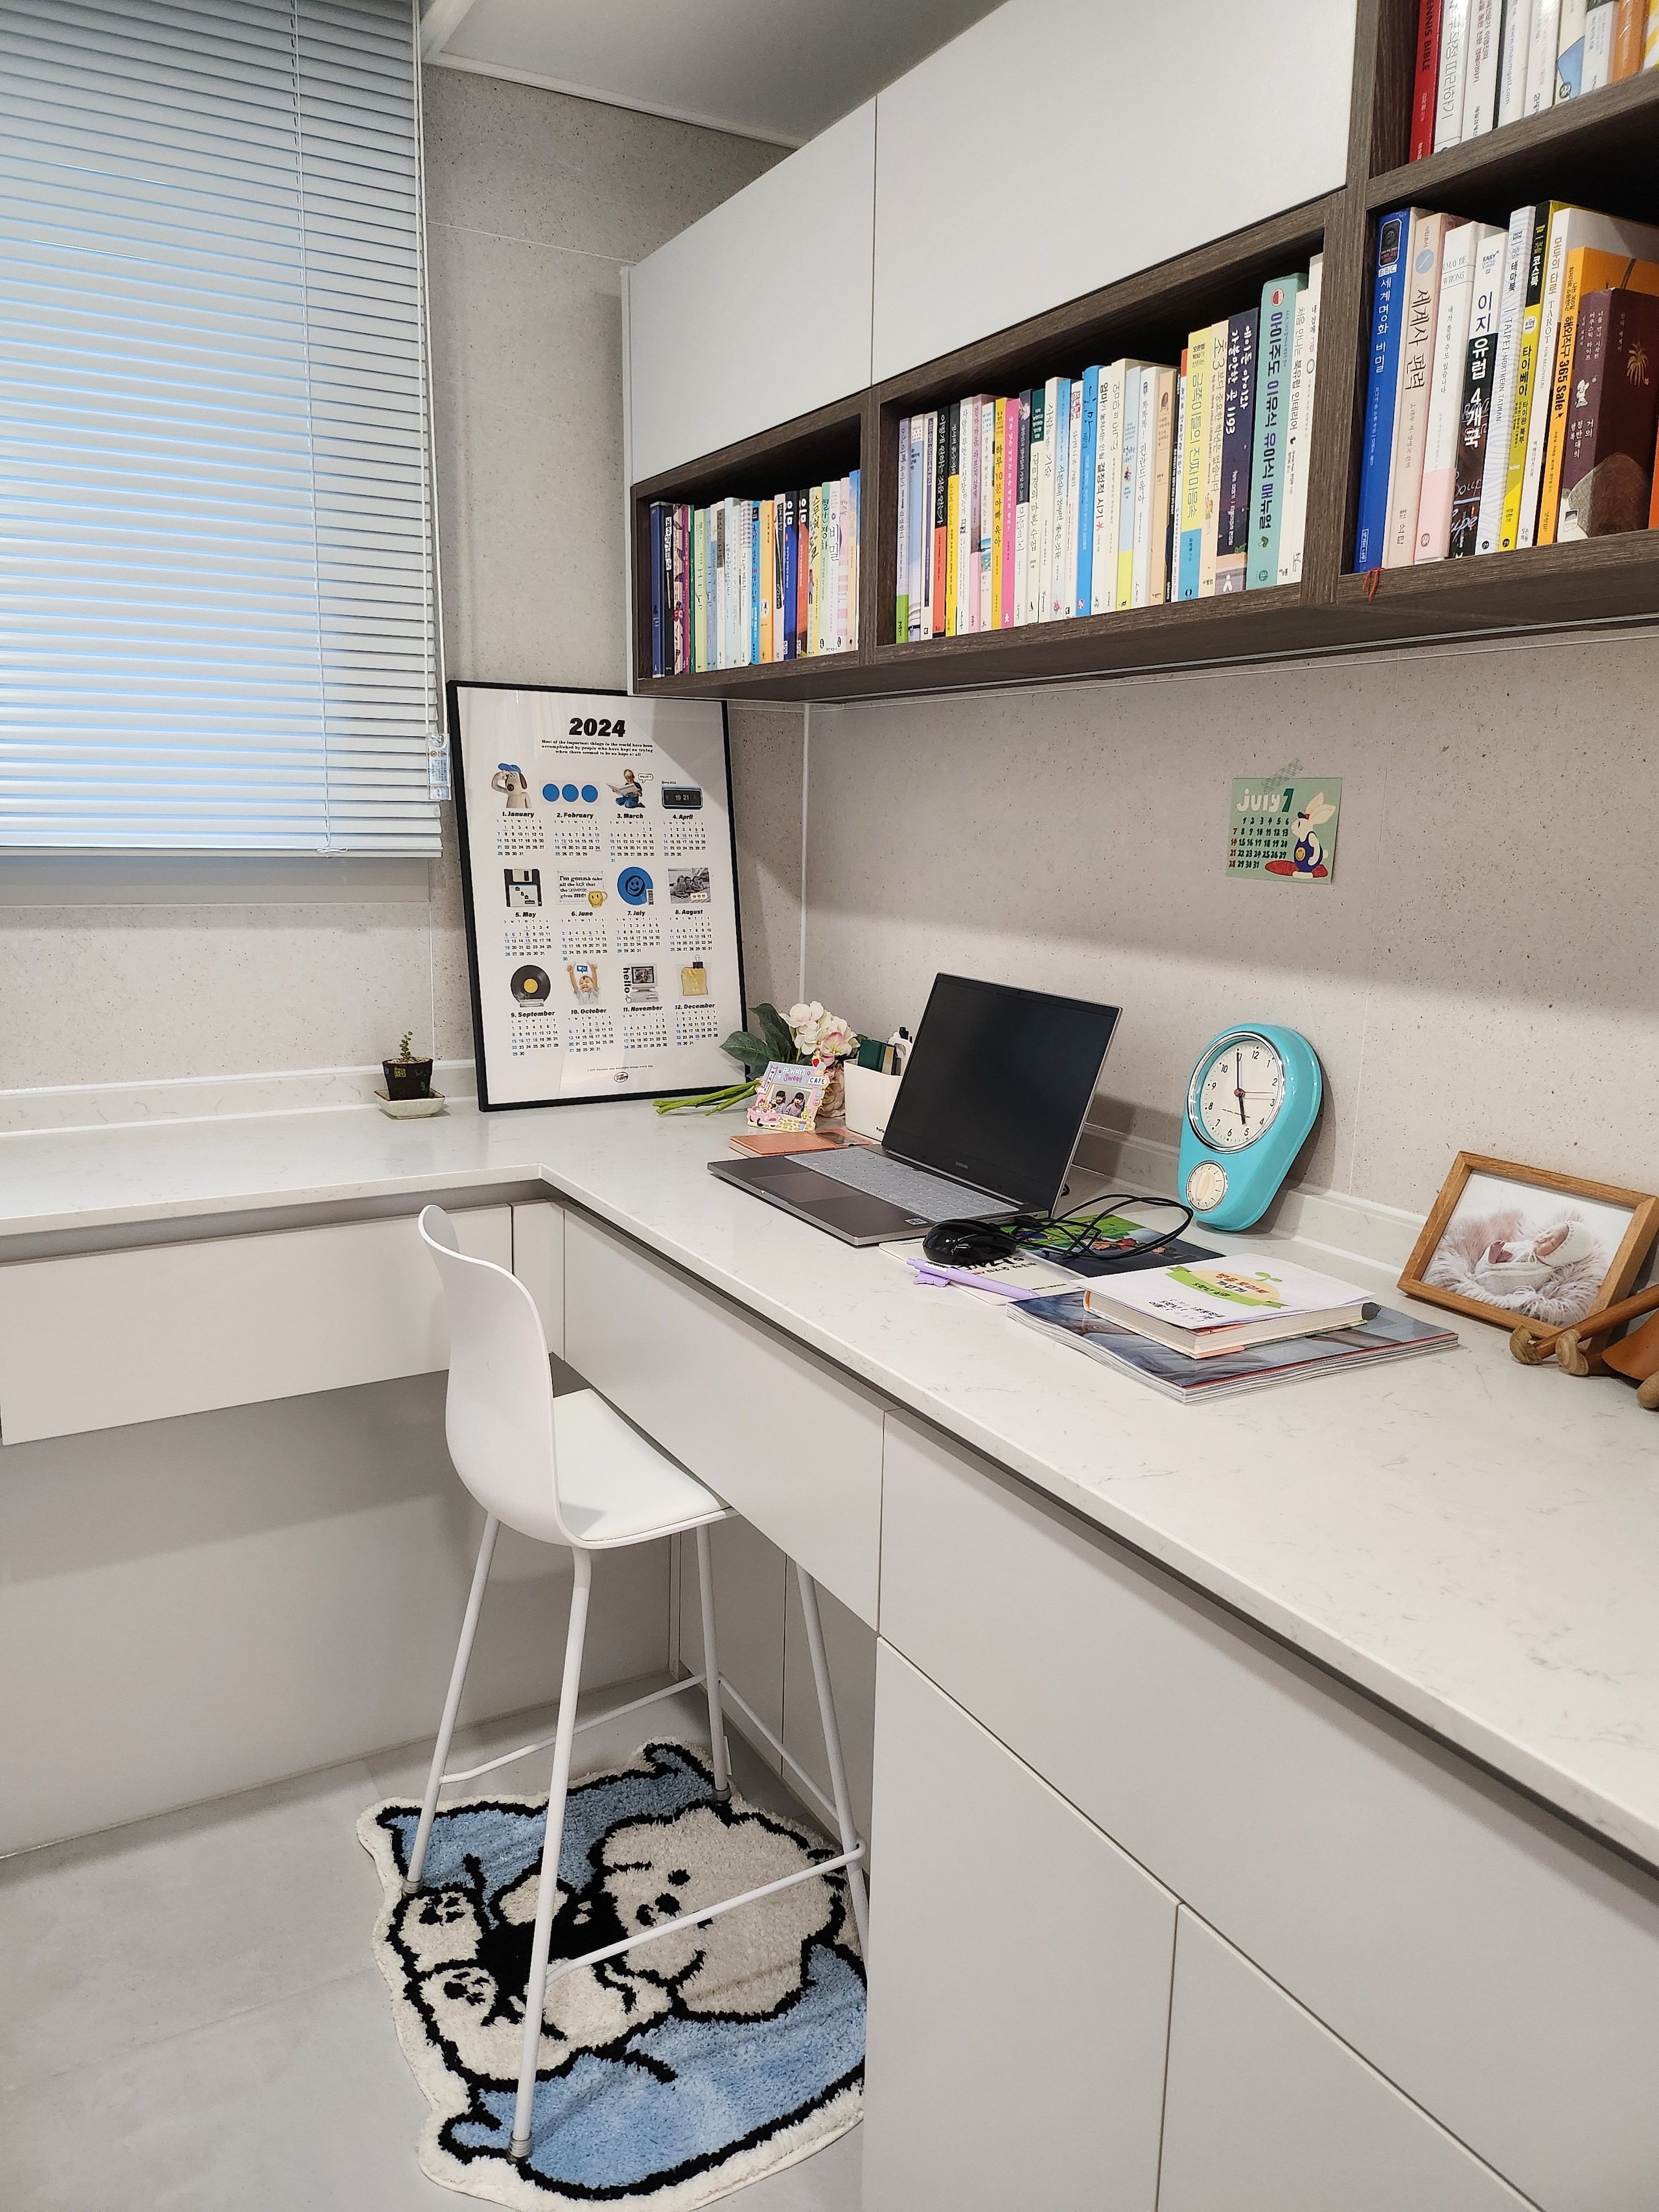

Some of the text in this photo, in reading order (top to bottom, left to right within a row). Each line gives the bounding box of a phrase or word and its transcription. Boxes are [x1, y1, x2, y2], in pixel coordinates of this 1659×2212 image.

[1422, 41, 1432, 72] BIBLE
[1441, 60, 1457, 120] 따라하기
[1378, 264, 1397, 277] BBC
[1446, 258, 1458, 270] MAY
[1459, 255, 1467, 265] BE
[1483, 253, 1496, 262] EASY
[1530, 255, 1541, 287] 코스북
[1443, 271, 1465, 285] WRONG
[1508, 261, 1518, 292] 테마북
[1375, 277, 1392, 373] 세계명화 비밀
[1545, 300, 1555, 343] TAROT
[1405, 289, 1431, 390] 세계사 편력
[1560, 316, 1573, 358] 해외직구
[1444, 343, 1450, 360] 수도
[1216, 371, 1225, 390] 보다
[1240, 325, 1253, 410] 에이든 아이와
[1290, 307, 1305, 430] 처음 만나는 북유럽 인테리어
[1464, 291, 1493, 448] 이지 유럽 4개국
[1498, 354, 1509, 393] NORTHERN
[1518, 344, 1532, 397] 타이베이
[1557, 360, 1570, 383] 365
[1225, 329, 1240, 435] 가볼만한 곳 1193
[1215, 393, 1224, 422] 중요한
[1495, 393, 1504, 423] TAIWAN
[1554, 384, 1567, 411] Sale
[1259, 312, 1283, 530] 아이주도 이유식 유아식 매뉴얼
[1570, 422, 1577, 441] 행복
[1584, 418, 1594, 438] 거의
[1187, 373, 1203, 518] 금쪽이들의 진짜 마음속
[1213, 424, 1222, 452] 학년은
[1573, 420, 1583, 458] 정반대의
[996, 444, 1003, 467] 하루
[1031, 452, 1039, 500] 김미경의
[1096, 462, 1106, 495] 결정적
[1211, 455, 1220, 493] 없습니다
[1096, 498, 1104, 518] 시기
[830, 524, 839, 561] 비밀
[1030, 528, 1038, 552] 수업
[569, 717, 626, 738] 2024
[1282, 789, 1294, 812] 7
[1233, 828, 1288, 836] 7 8 9 10 11 12 13
[1220, 1064, 1228, 1073] 10
[1251, 1050, 1260, 1060] 12
[1267, 1060, 1271, 1068] 1
[1271, 1078, 1278, 1086] 2
[1214, 1119, 1221, 1127] 7
[1227, 1128, 1233, 1137] 6
